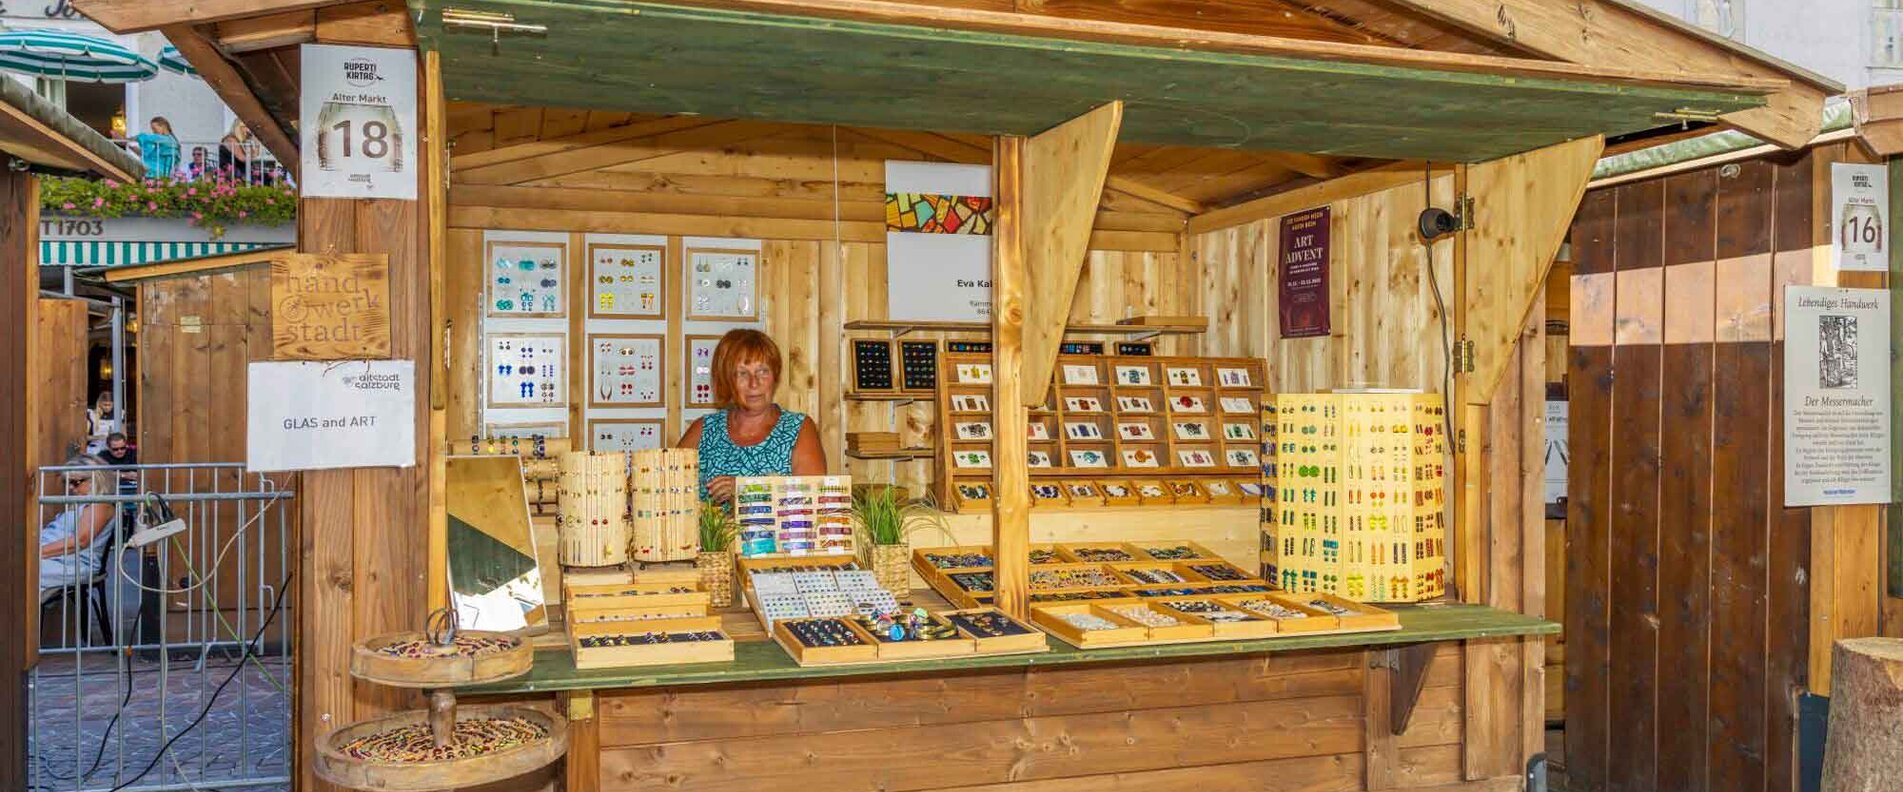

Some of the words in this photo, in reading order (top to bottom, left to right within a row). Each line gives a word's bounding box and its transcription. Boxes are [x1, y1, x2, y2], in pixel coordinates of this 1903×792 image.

[343, 61, 377, 72] RUPERTI
[346, 71, 374, 80] KIRTAG
[332, 92, 356, 102] Alter
[358, 94, 388, 104] Markt
[332, 120, 389, 159] 18
[58, 220, 104, 236] 1703
[1849, 216, 1876, 243] 16
[1294, 234, 1314, 249] ART
[1285, 247, 1324, 264] ADVENT
[285, 270, 361, 294] hand
[957, 279, 974, 288] Eva
[304, 287, 380, 317] werk
[1798, 295, 1838, 310] Lebendiges
[1840, 297, 1880, 310] Handwerk
[285, 317, 362, 343] stadt
[354, 380, 401, 391] salzburg
[358, 373, 400, 383] altstadt
[1804, 395, 1820, 407] Der
[1821, 394, 1874, 407] Messermacher
[283, 417, 319, 431] GLAS
[322, 416, 346, 429] and
[349, 415, 378, 427] ART
